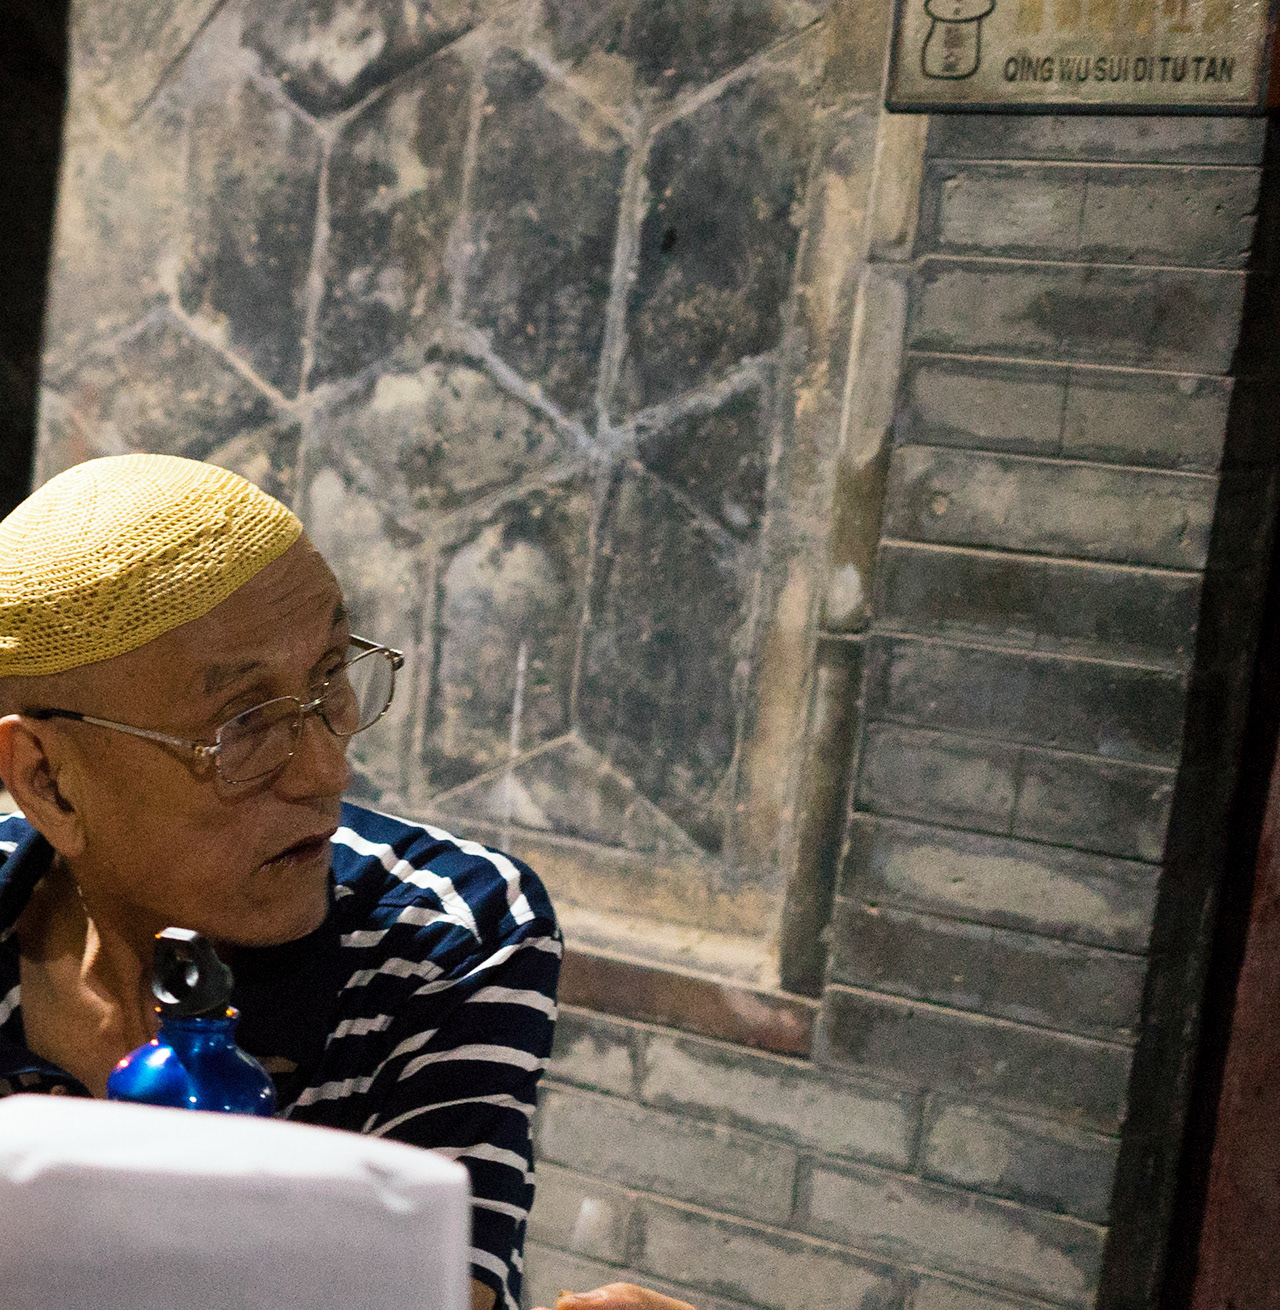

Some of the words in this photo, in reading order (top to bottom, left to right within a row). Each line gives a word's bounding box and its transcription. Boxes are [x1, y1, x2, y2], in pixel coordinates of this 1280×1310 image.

[1003, 56, 1055, 82] QING
[1159, 56, 1188, 82] TU
[1192, 56, 1236, 82] TAN
